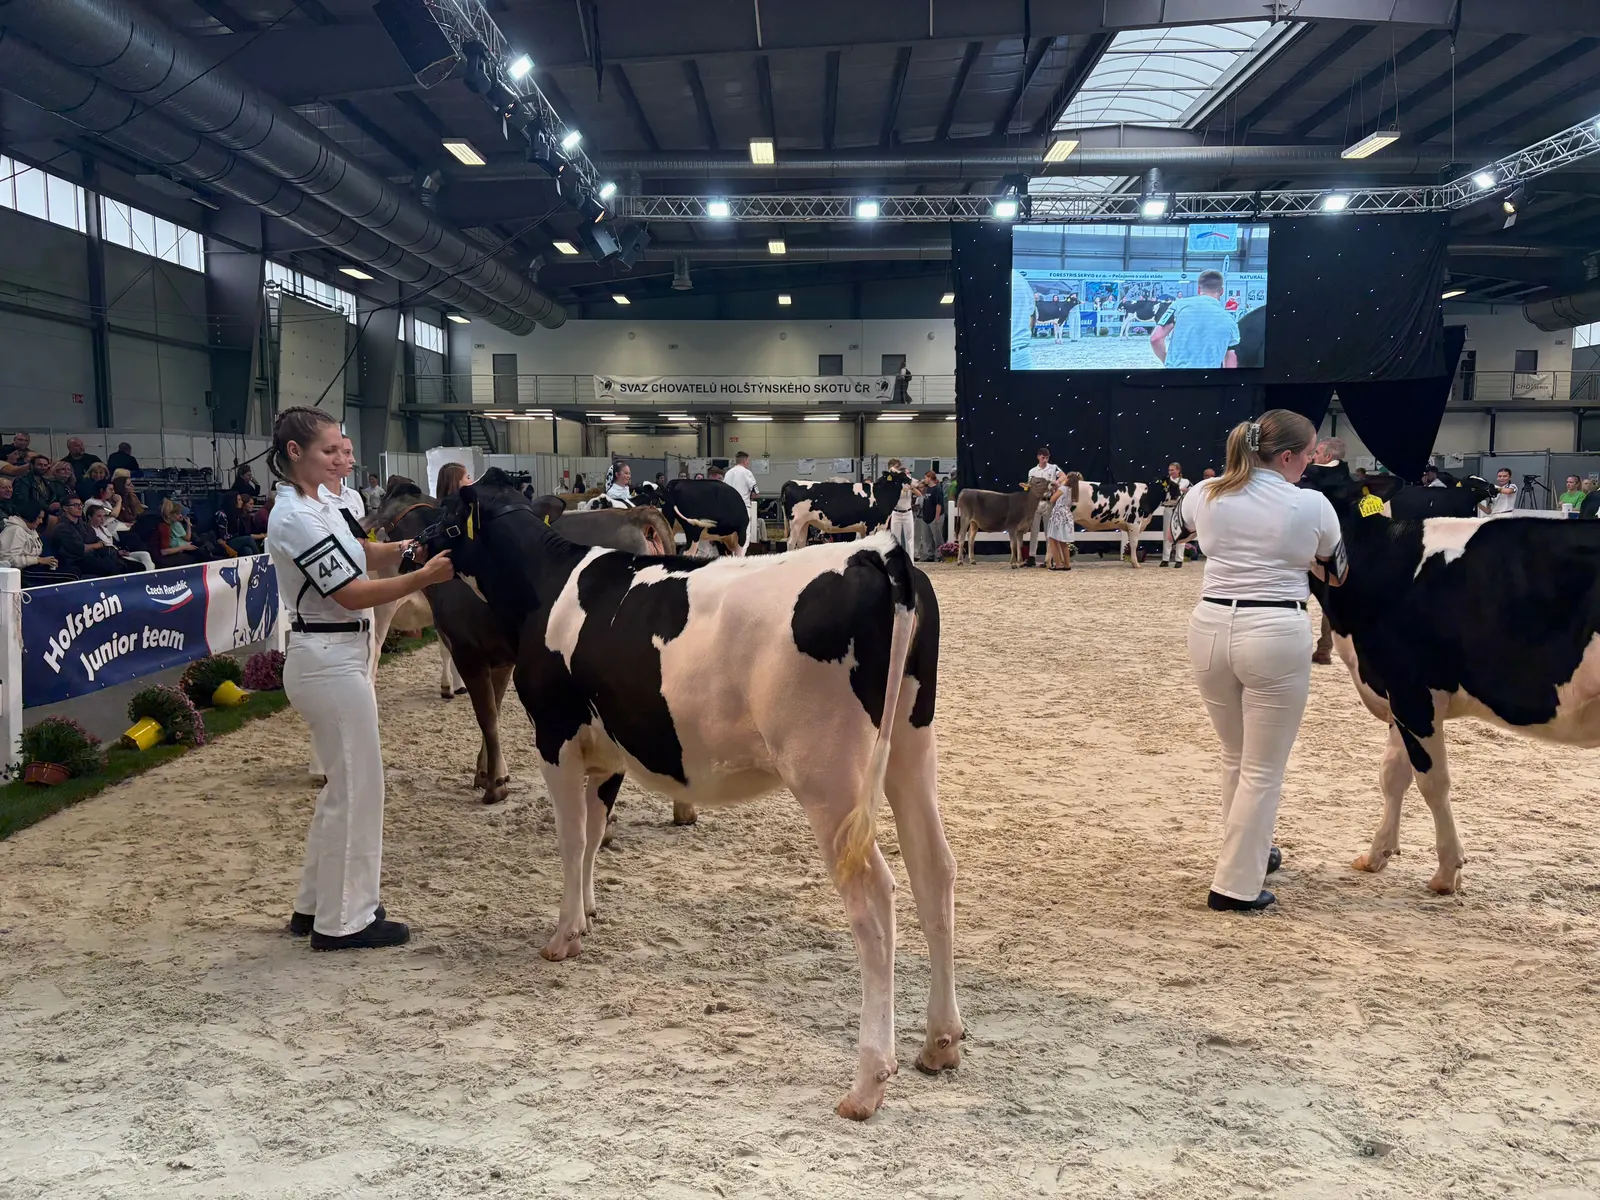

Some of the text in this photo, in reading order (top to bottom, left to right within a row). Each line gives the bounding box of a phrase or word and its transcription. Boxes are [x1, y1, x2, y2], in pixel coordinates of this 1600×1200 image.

[620, 381, 870, 394] SVAZ CHOVATELŮ HOLŠTÝNSKÉHO SKOTU ČR
[318, 554, 343, 579] 44
[145, 579, 188, 595] Czech Republic
[43, 591, 123, 674] Holstein
[80, 625, 185, 682] Junior team
